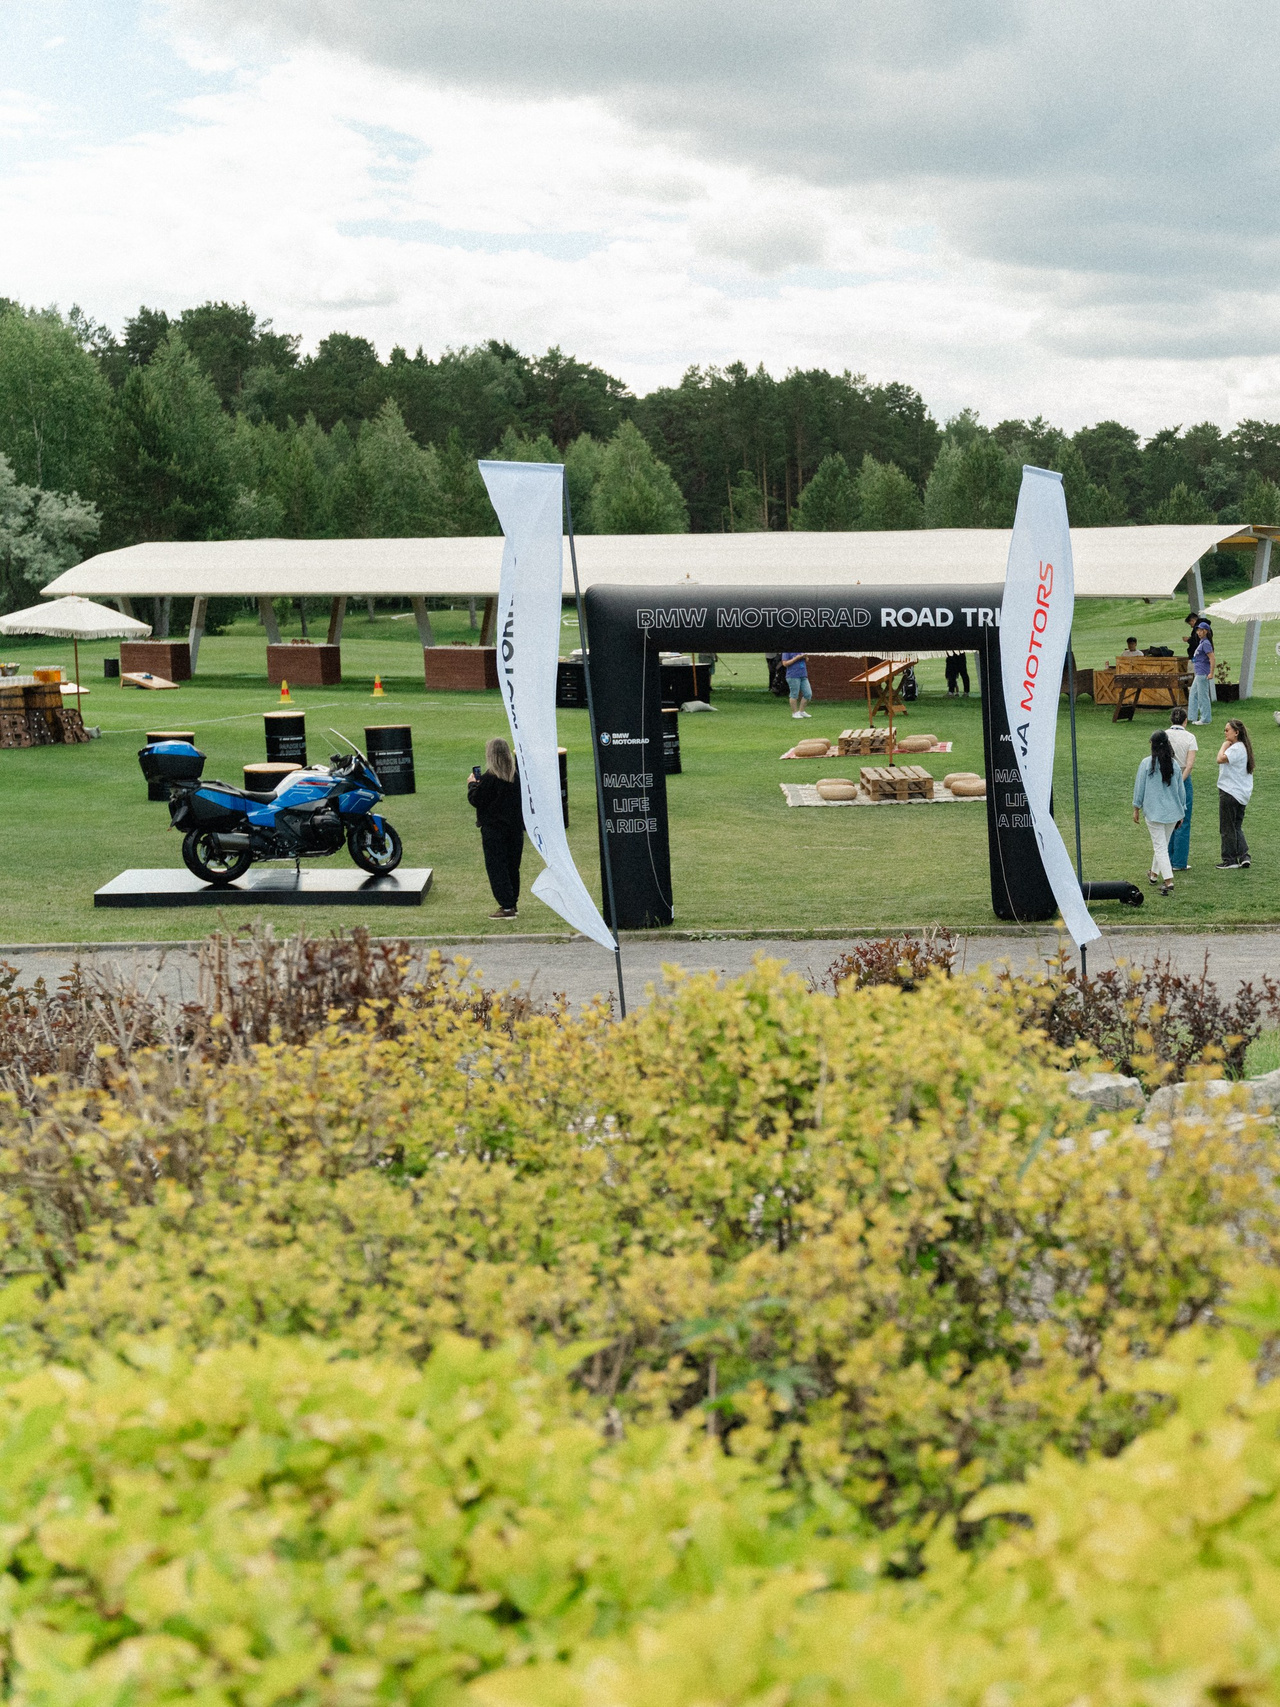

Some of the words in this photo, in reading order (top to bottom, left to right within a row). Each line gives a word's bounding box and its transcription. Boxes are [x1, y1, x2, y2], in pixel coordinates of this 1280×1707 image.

[636, 608, 707, 629] BMW
[717, 607, 872, 628] MOTORRAD
[880, 607, 954, 628] ROAD
[961, 607, 1001, 628] TRI
[1020, 560, 1054, 712] MOTORS
[603, 773, 654, 788] MAKE
[994, 768, 1023, 783] MA
[613, 797, 650, 813] LIFE
[1005, 793, 1029, 807] LIF
[605, 819, 615, 833] A
[617, 818, 658, 833] RIDE
[998, 814, 1010, 828] A
[1011, 814, 1034, 828] RI
